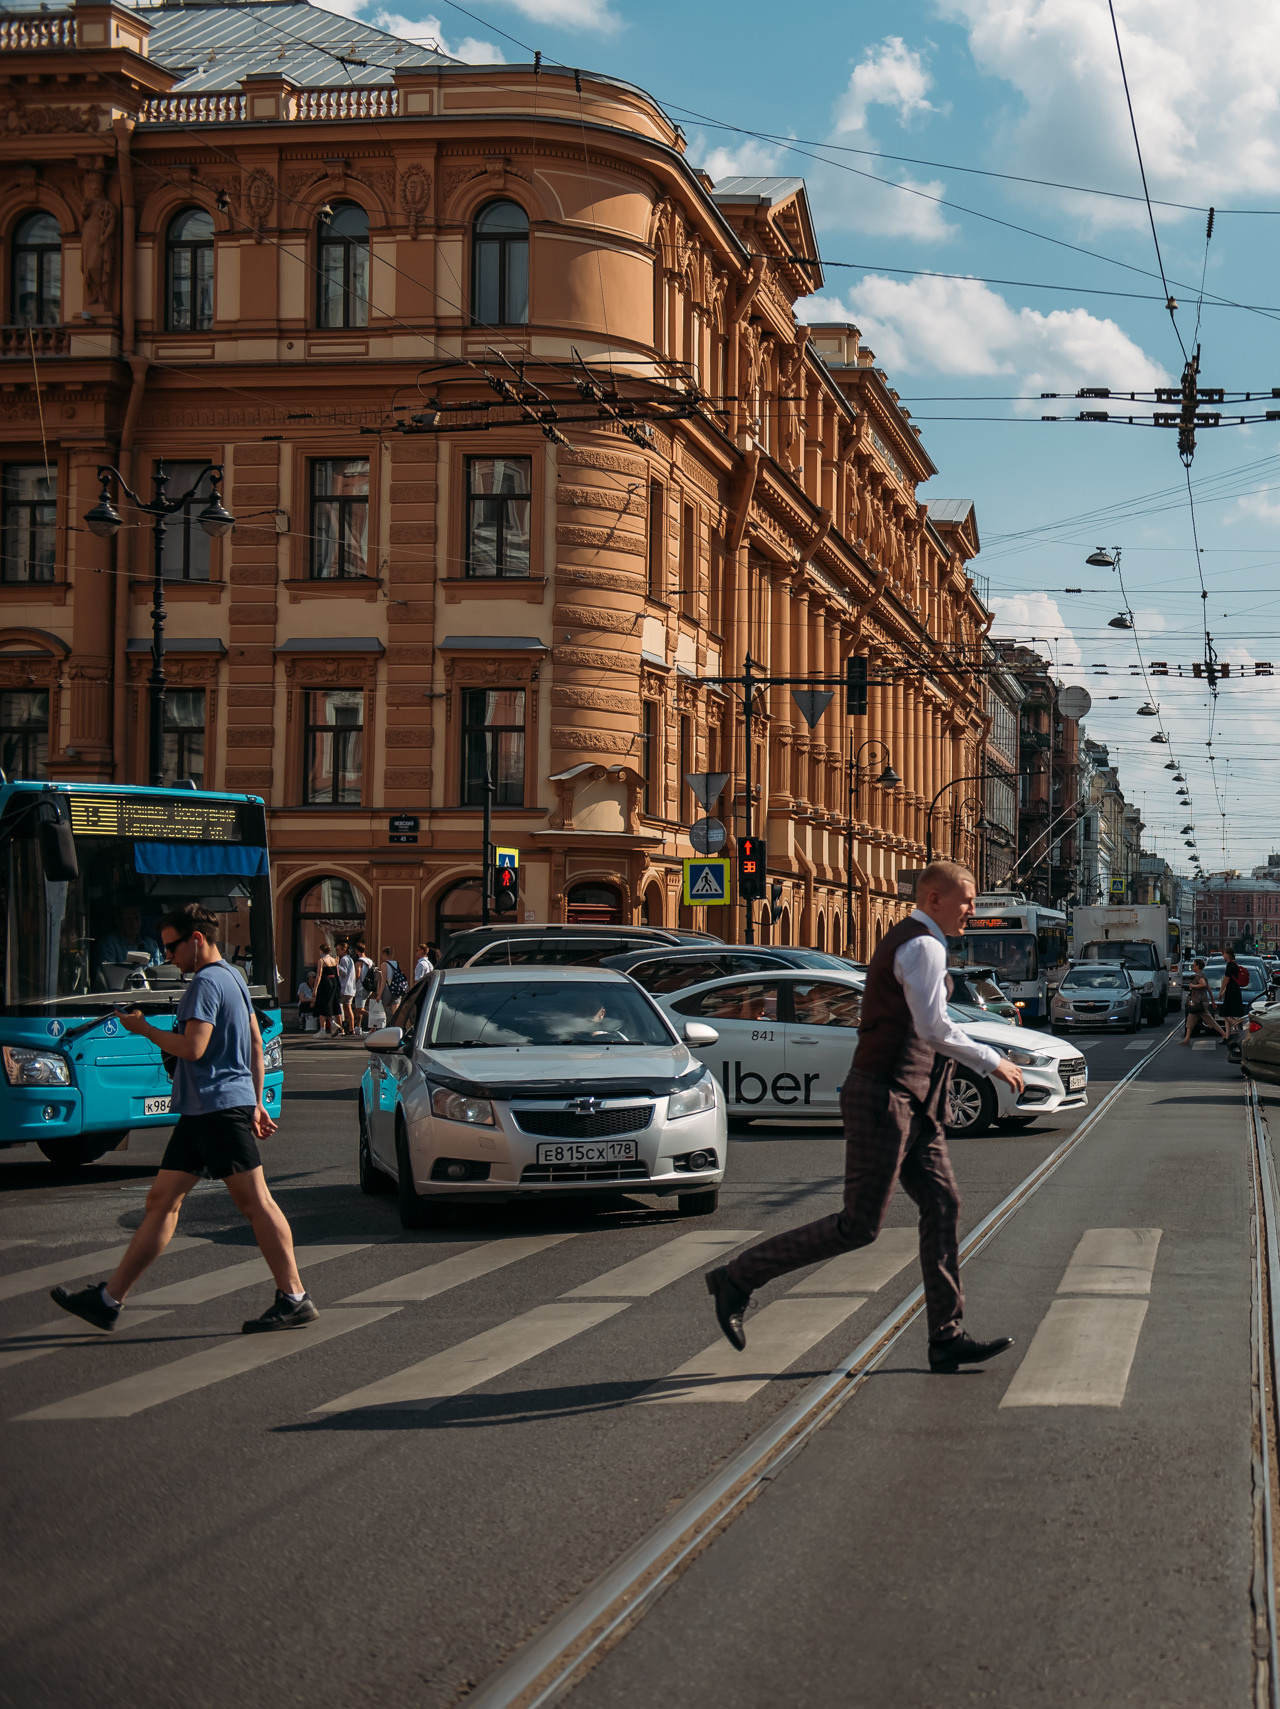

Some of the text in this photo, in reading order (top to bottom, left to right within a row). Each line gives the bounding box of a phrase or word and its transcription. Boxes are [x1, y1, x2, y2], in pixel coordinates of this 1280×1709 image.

[743, 860, 757, 873] 38
[751, 1030, 776, 1042] 841
[544, 1143, 632, 1162] Е815СХ 178
